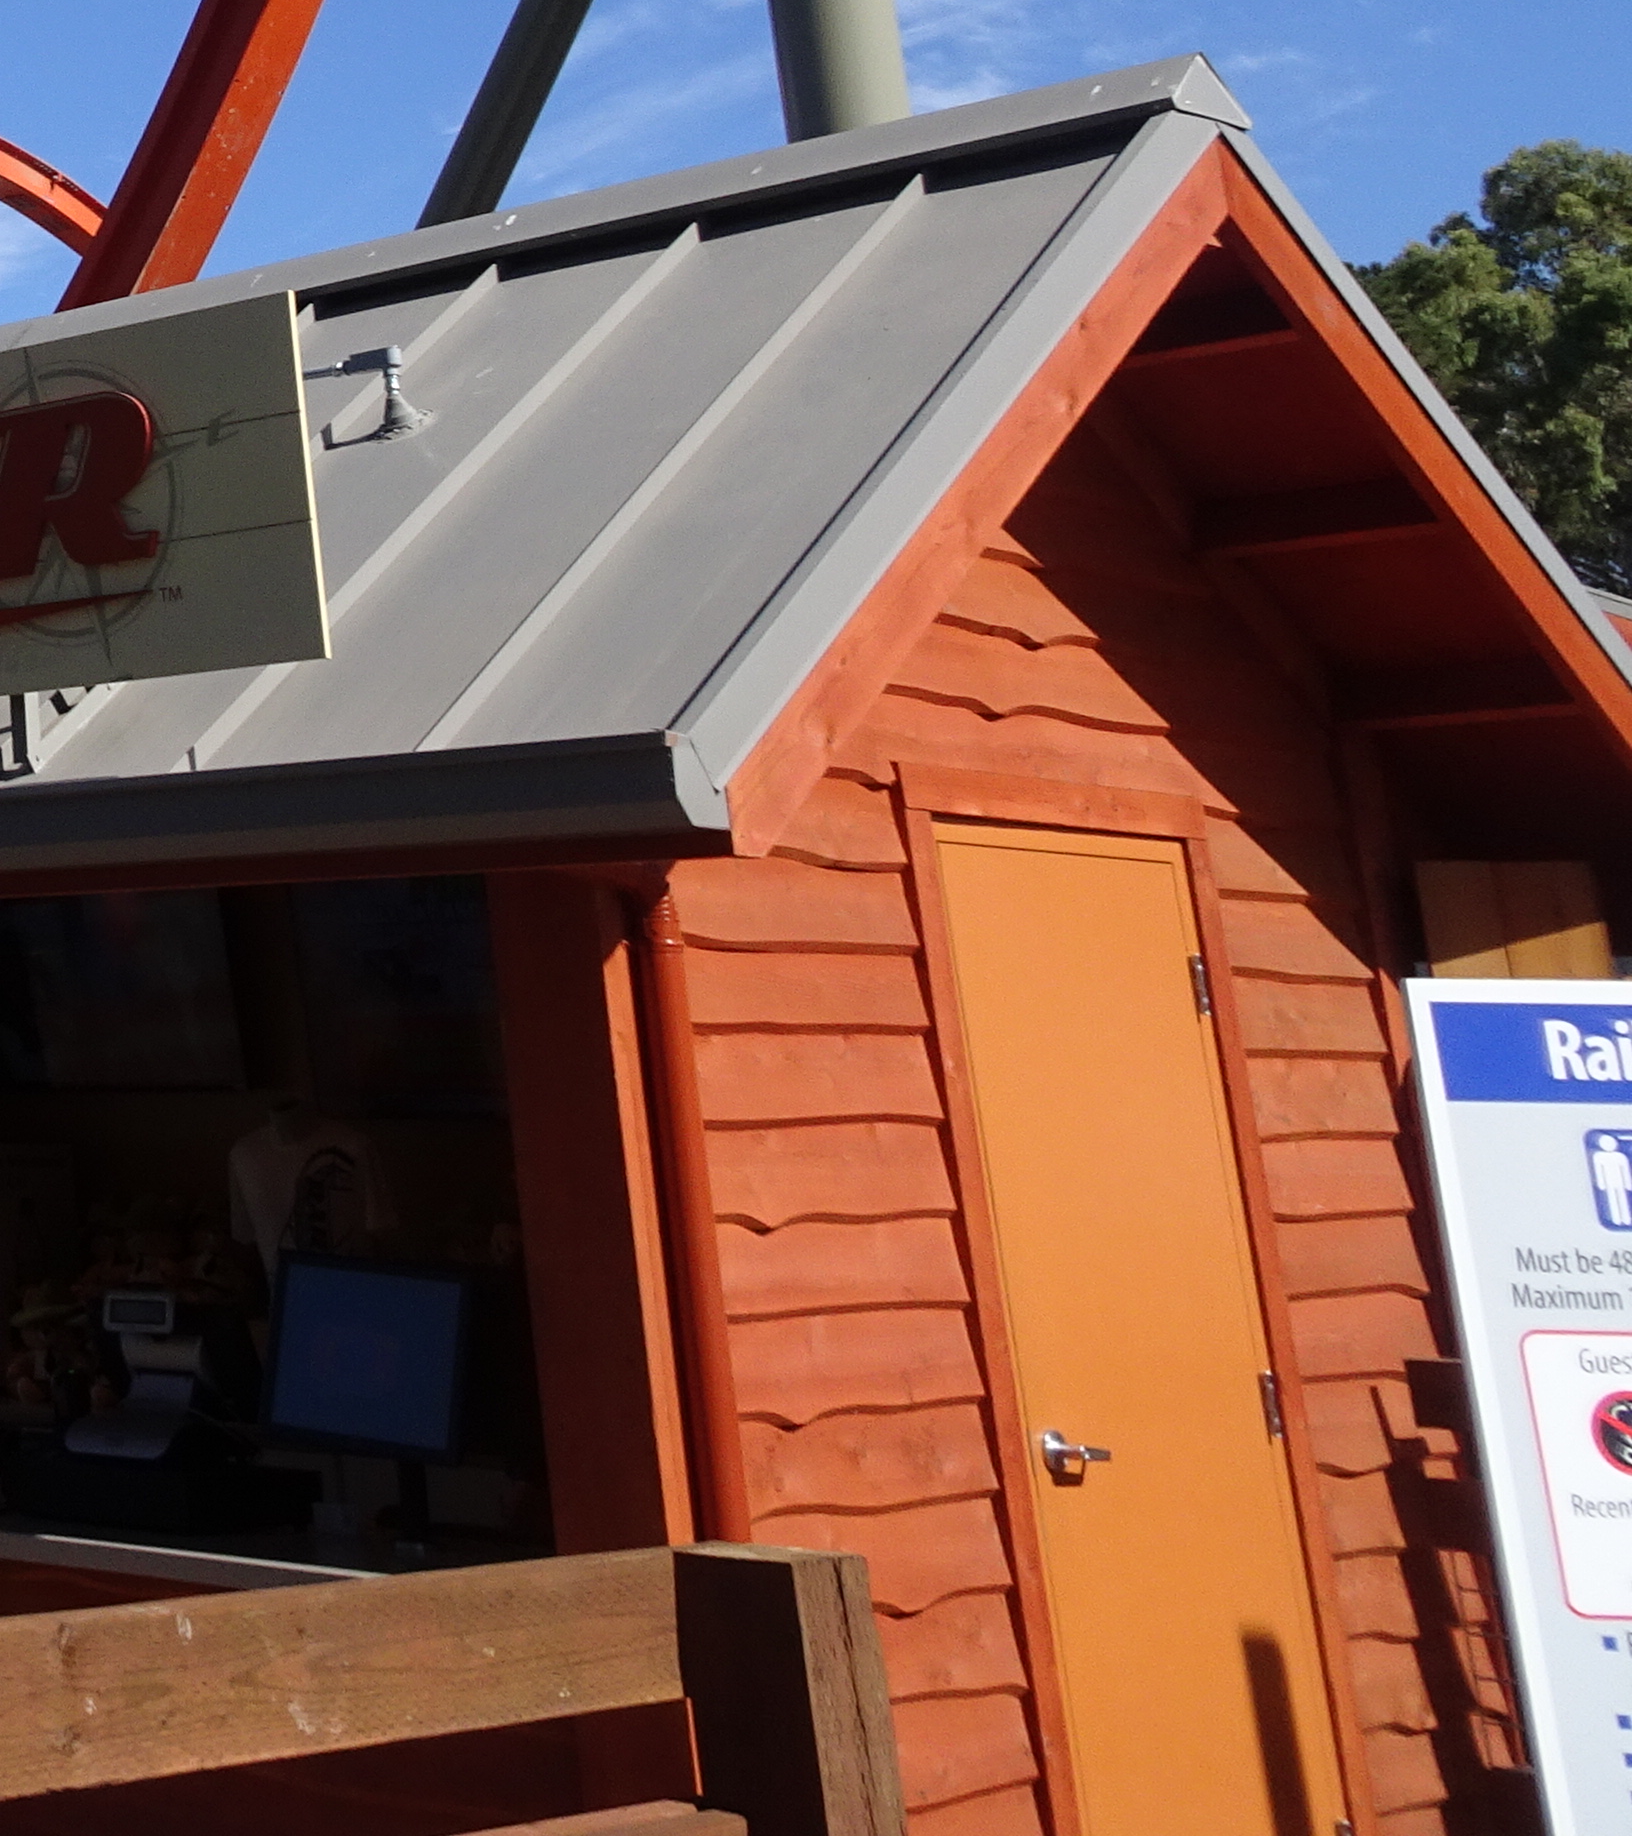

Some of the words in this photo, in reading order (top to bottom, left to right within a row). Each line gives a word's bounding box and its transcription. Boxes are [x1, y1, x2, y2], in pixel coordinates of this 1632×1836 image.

[159, 585, 183, 602] TM
[1543, 1019, 1632, 1081] Rai
[1515, 1247, 1571, 1273] Must
[1574, 1247, 1603, 1274] be
[1511, 1283, 1624, 1310] Maximum
[1578, 1348, 1632, 1374] Gues
[1570, 1494, 1632, 1518] Recen
